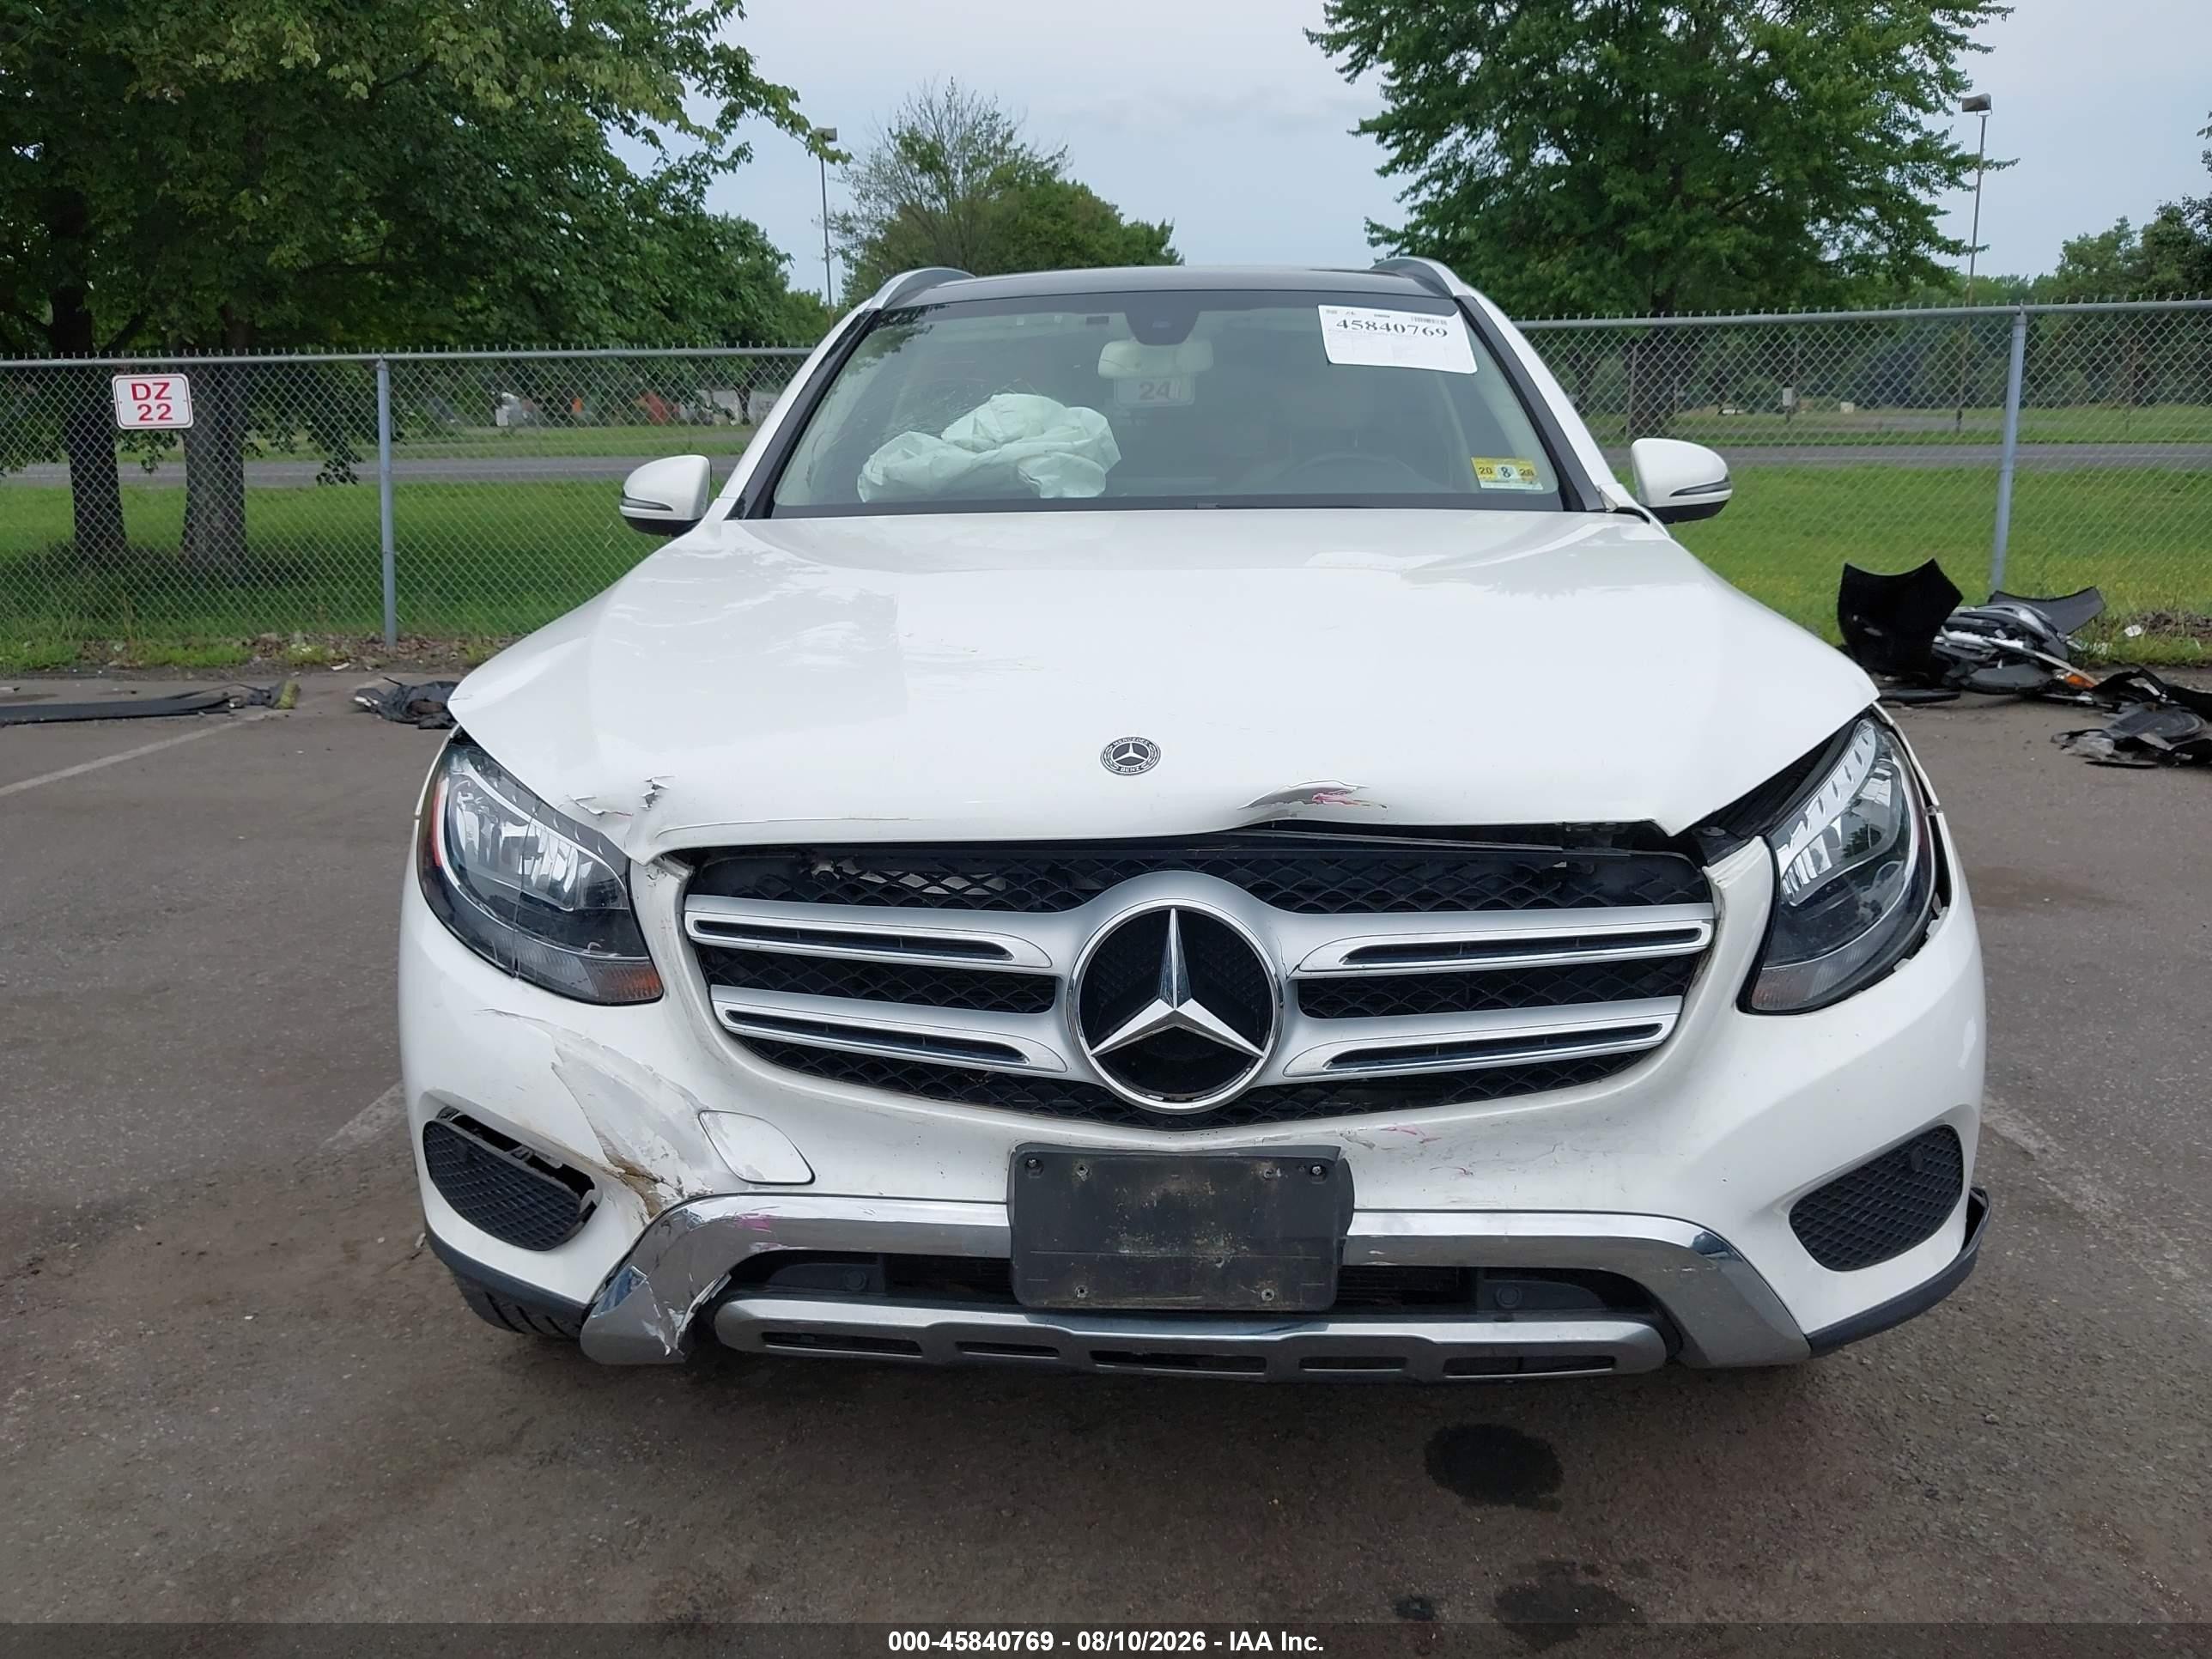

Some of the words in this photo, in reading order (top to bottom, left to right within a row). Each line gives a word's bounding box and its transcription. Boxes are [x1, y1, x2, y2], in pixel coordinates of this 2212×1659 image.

[1335, 318, 1449, 338] 45840769
[131, 381, 173, 401] DZ
[137, 403, 173, 422] 22
[1500, 466, 1511, 478] 8
